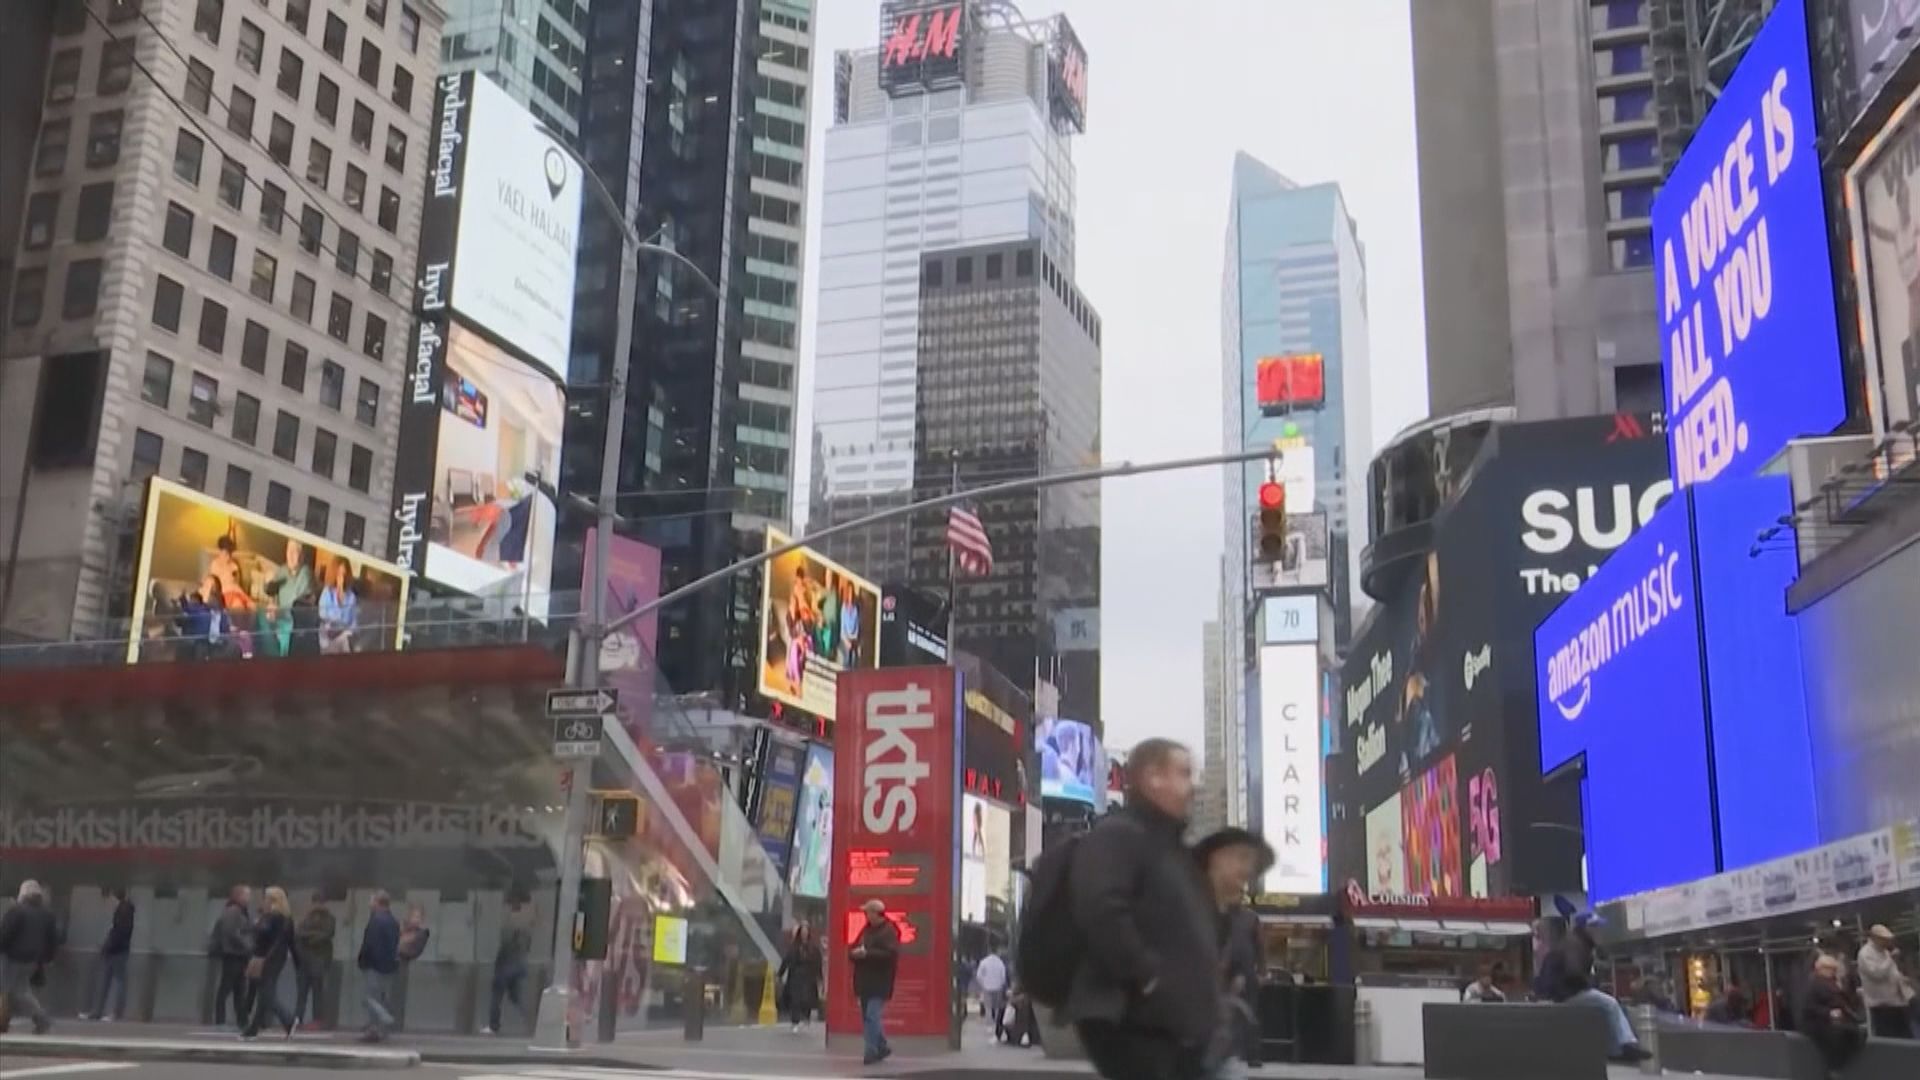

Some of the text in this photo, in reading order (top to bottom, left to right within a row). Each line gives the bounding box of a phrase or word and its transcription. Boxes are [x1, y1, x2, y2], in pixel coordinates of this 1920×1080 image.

[498, 176, 526, 223] YAEL
[1664, 67, 1794, 324] A VOICE IS
[1671, 216, 1772, 416] ALL YOU
[1674, 376, 1748, 490] NEED.
[1281, 610, 1300, 630] 70
[1520, 567, 1581, 596] The
[1548, 541, 1682, 703] amazon music
[863, 683, 934, 834] tkts
[1281, 704, 1300, 845] CLARK
